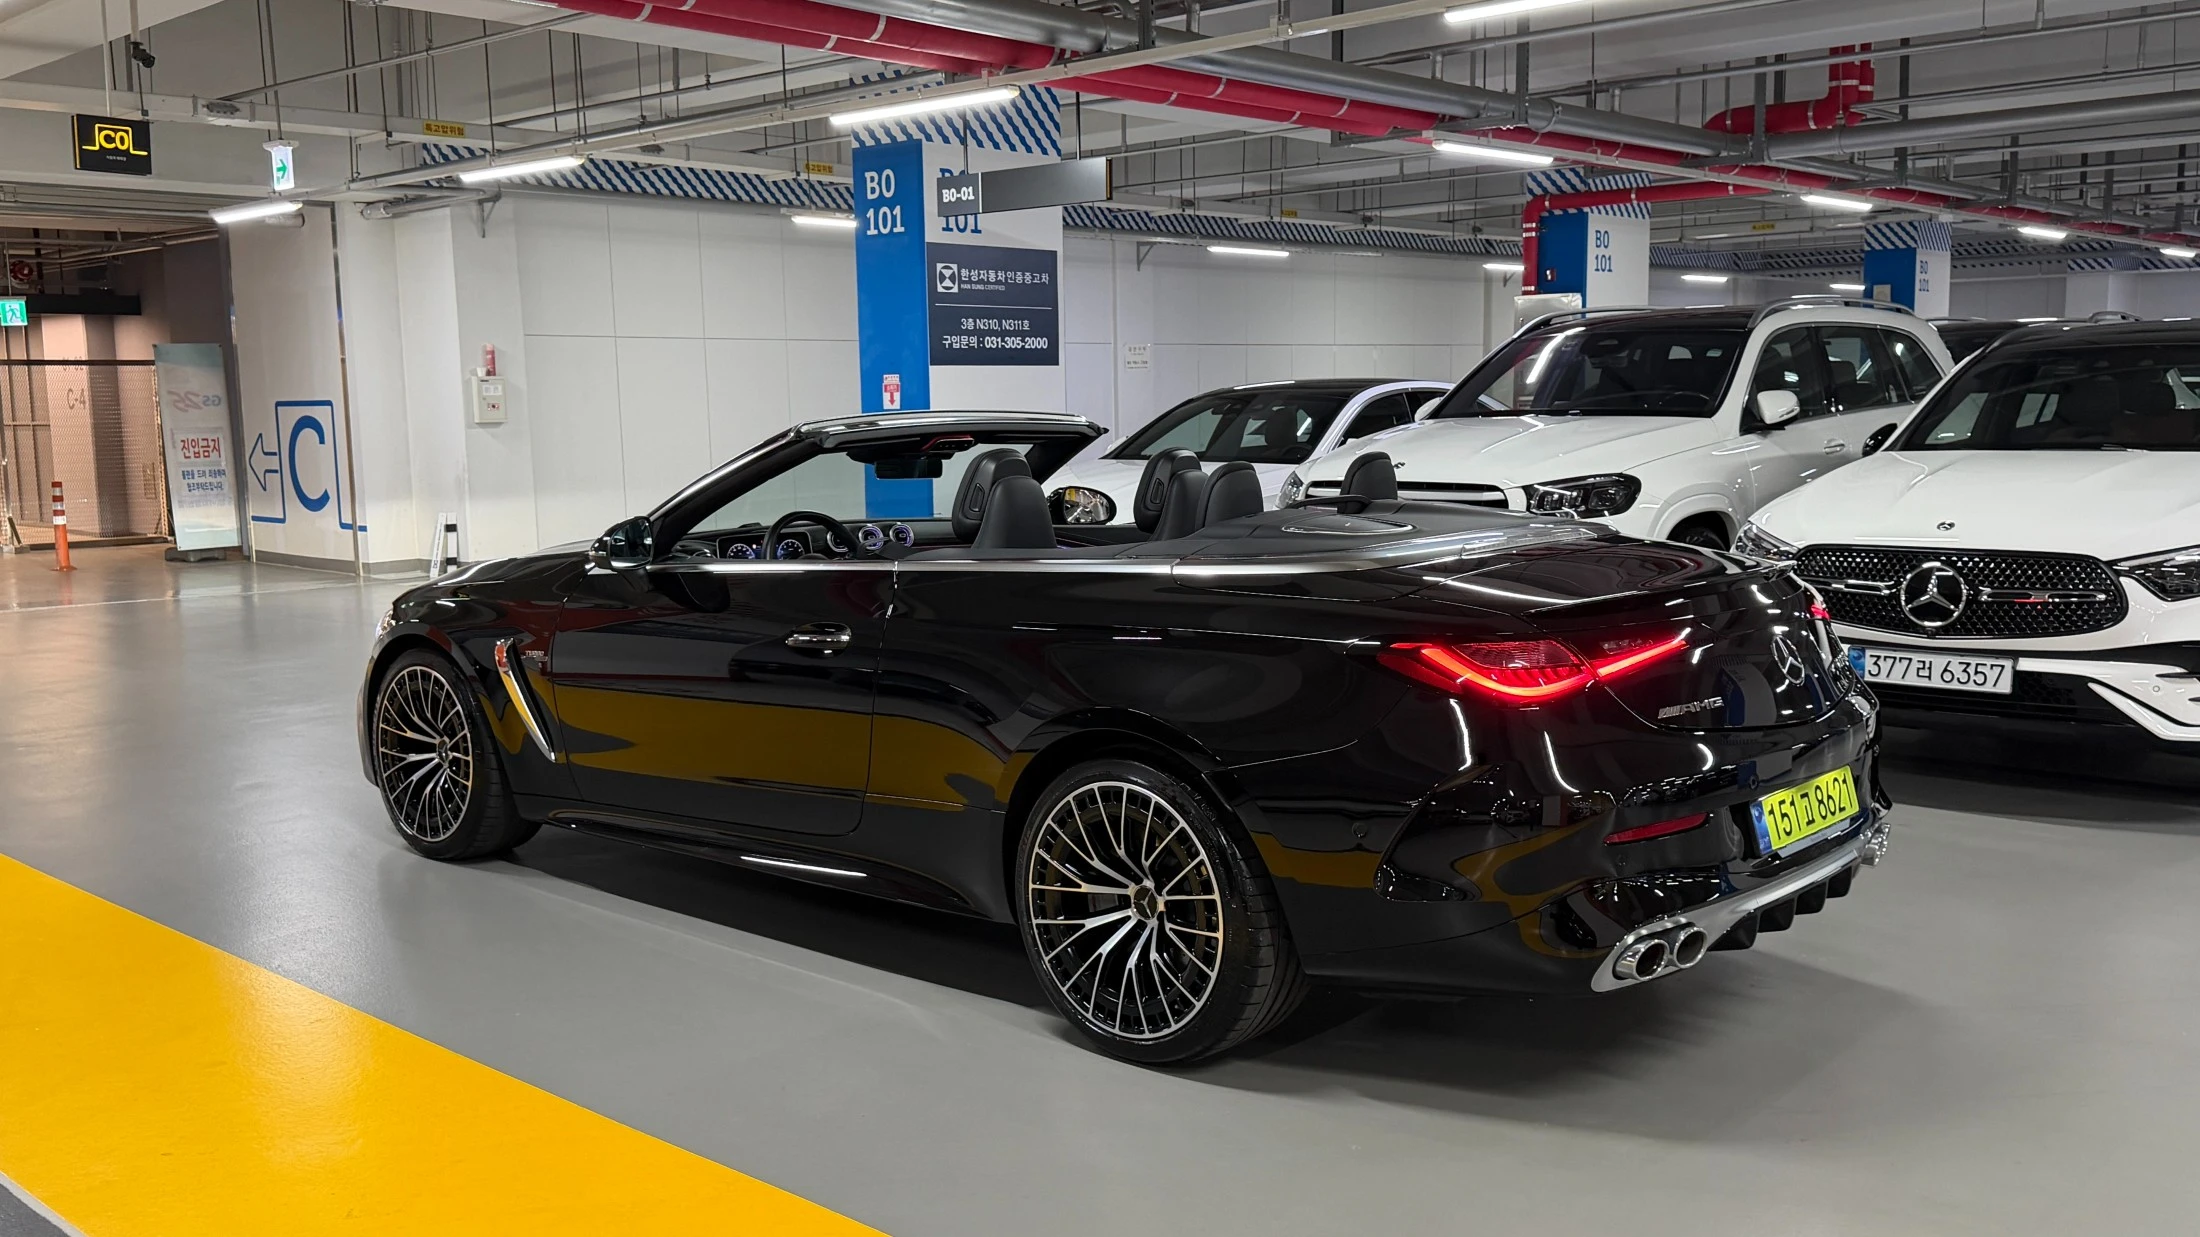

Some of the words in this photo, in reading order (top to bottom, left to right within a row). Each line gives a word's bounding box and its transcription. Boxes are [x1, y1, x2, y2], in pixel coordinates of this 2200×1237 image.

[866, 205, 905, 235] 101
[1594, 254, 1613, 272] 101
[961, 318, 975, 330] 3층
[976, 319, 1001, 331] N310,
[1002, 319, 1031, 331] N311호
[942, 335, 978, 349] 구입문의
[984, 336, 1048, 349] 031-305-2000
[180, 437, 222, 459] 진입금지
[288, 415, 331, 512] C
[1868, 654, 1933, 681] 377러
[1940, 660, 2006, 688] 6357
[1768, 791, 1816, 841] 151고
[1814, 772, 1853, 821] 8621
